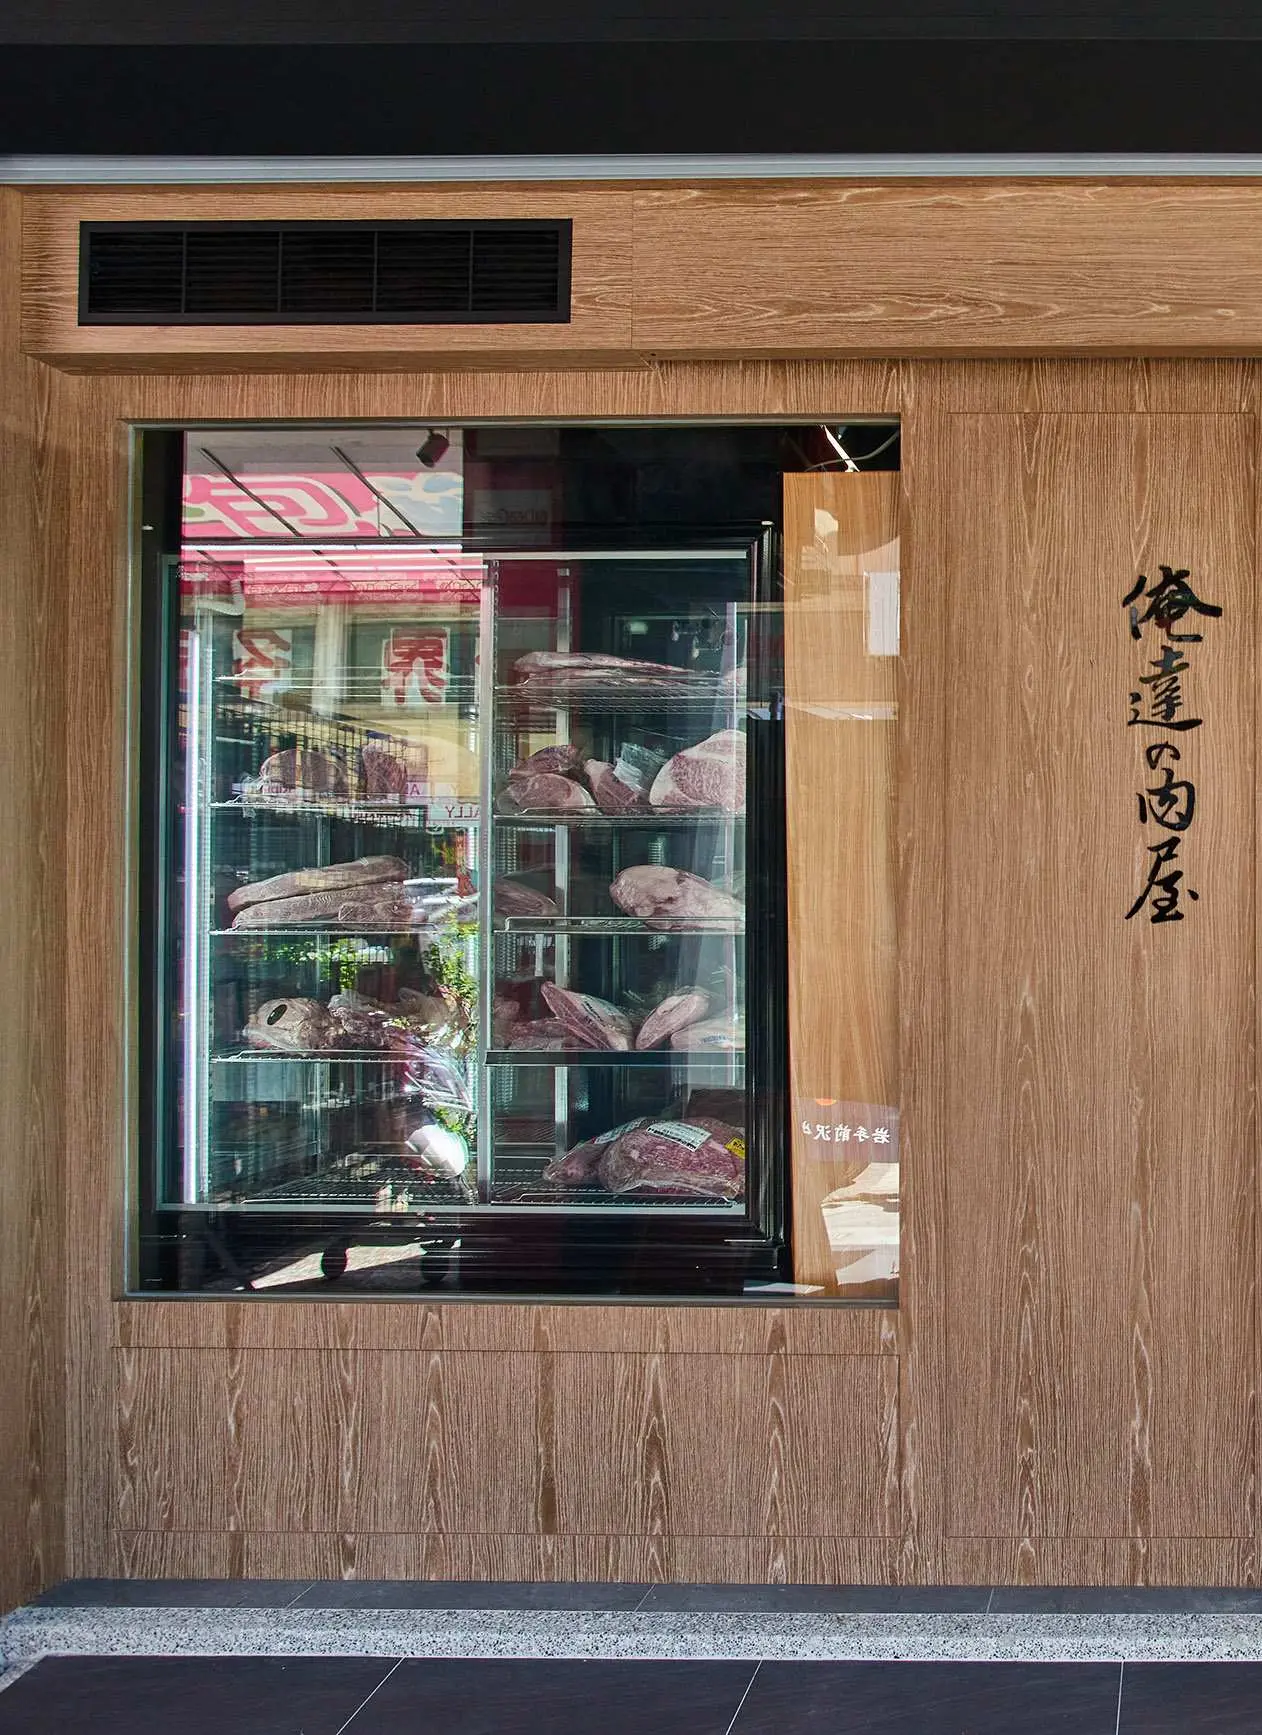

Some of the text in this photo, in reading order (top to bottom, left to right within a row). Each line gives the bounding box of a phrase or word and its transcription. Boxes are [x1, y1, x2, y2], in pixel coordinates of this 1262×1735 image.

[1122, 565, 1223, 924] 俺達の肉屋
